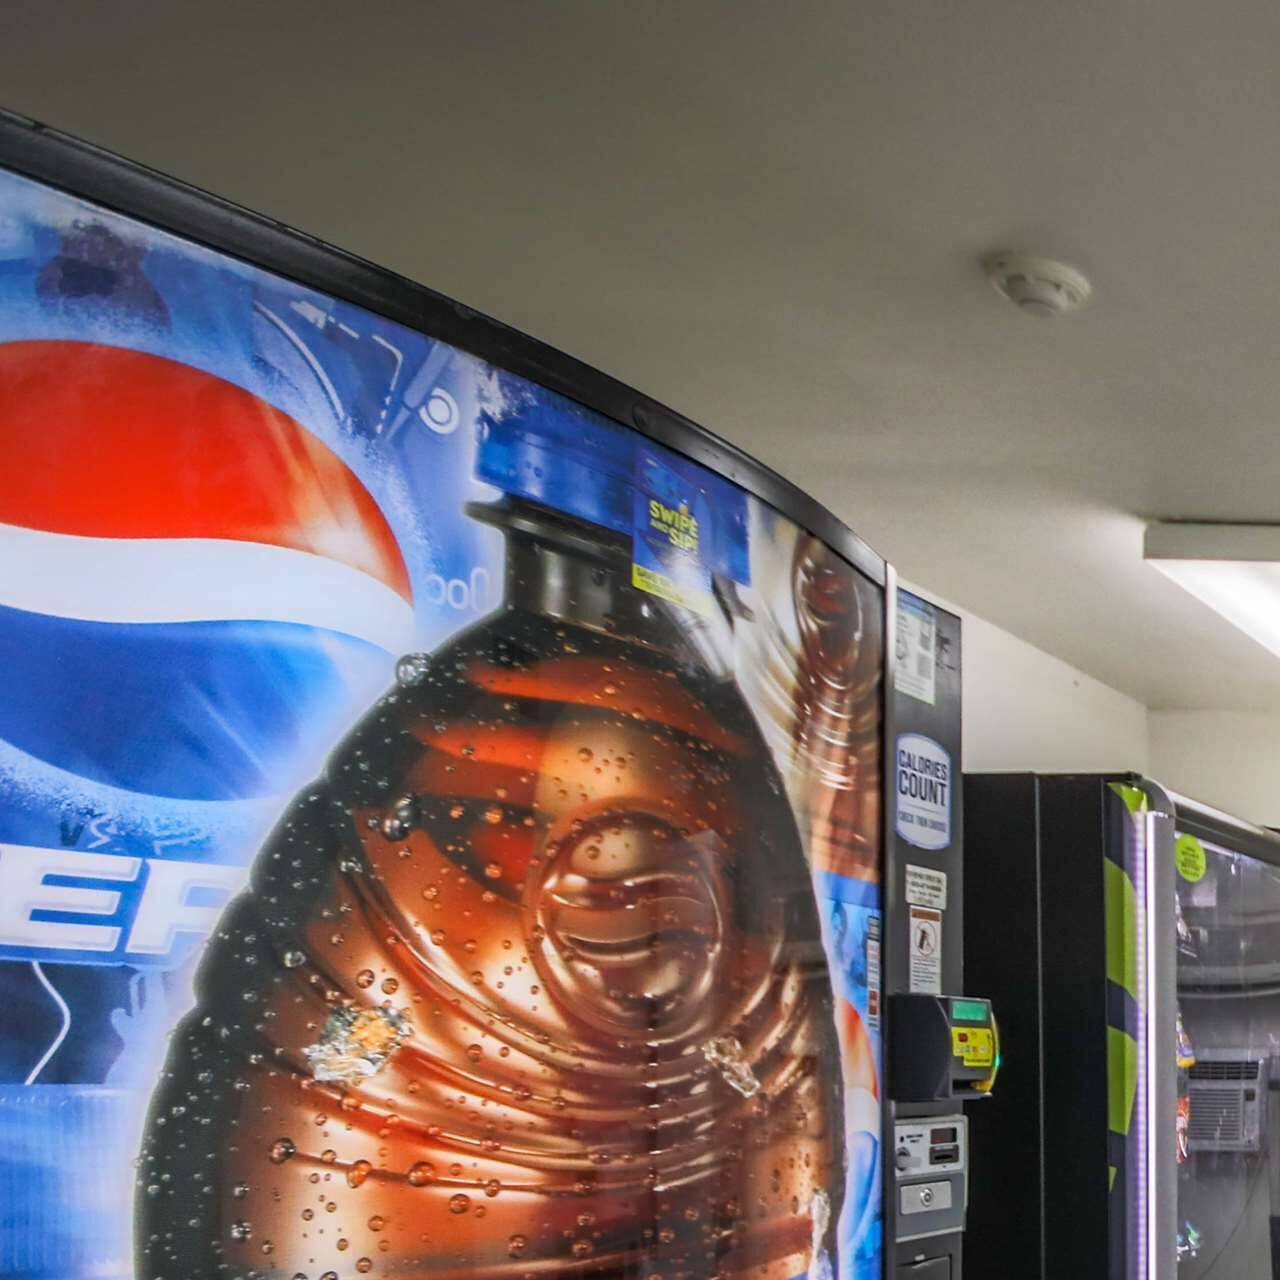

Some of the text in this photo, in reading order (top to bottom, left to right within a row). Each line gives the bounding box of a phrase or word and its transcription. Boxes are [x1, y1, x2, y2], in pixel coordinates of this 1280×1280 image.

[649, 500, 698, 538] SWIPE
[898, 749, 948, 781] CALORIES
[898, 769, 947, 807] COUNT
